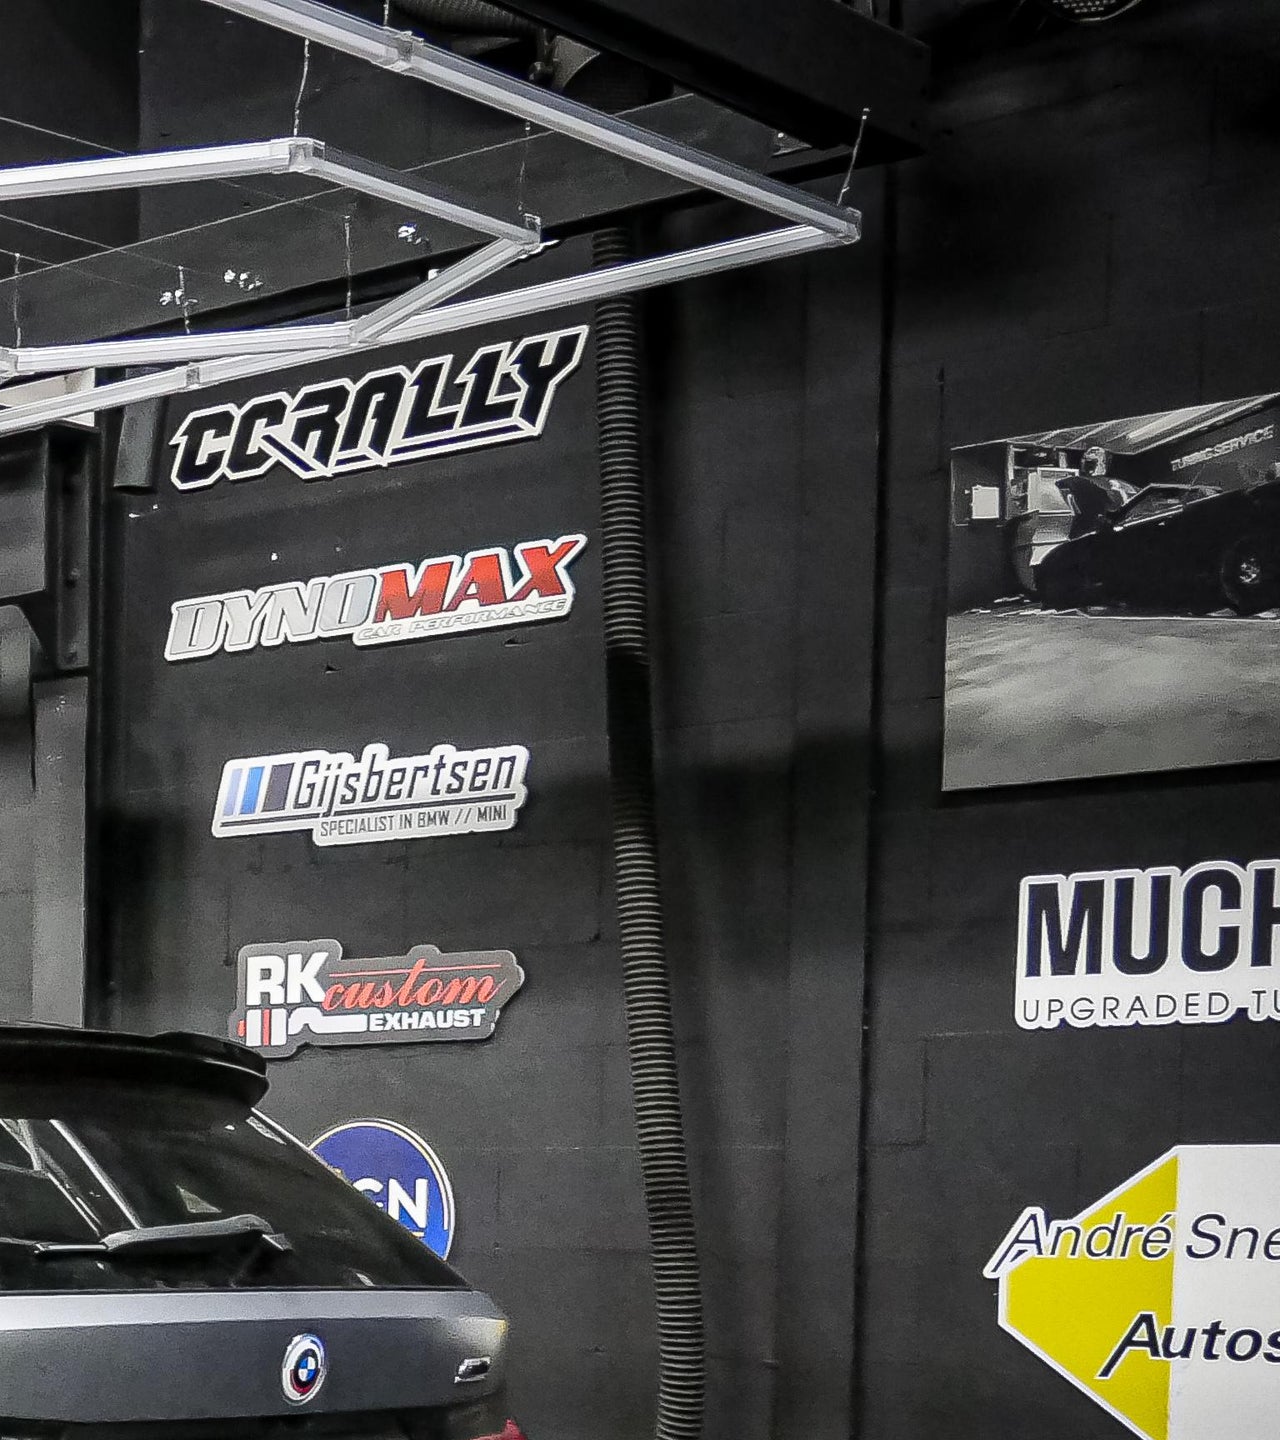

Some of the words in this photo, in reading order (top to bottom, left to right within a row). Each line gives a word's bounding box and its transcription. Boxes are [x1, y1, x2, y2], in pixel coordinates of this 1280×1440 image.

[169, 325, 589, 490] CCRALLY
[169, 539, 578, 656] DYNOMAX
[357, 626, 402, 641] CAR
[408, 599, 567, 633] PERFORMANCE
[292, 753, 517, 818] Gijsbertsen
[320, 815, 396, 837] SPECIALIST
[398, 813, 414, 830] IN
[417, 808, 450, 829] BMW
[476, 804, 508, 822] MINI
[245, 951, 329, 1007] RK
[321, 957, 506, 1011] custom
[368, 1008, 487, 1032] EXHAUST
[1023, 991, 1230, 1023] UPGRADED
[990, 1213, 1173, 1273] André
